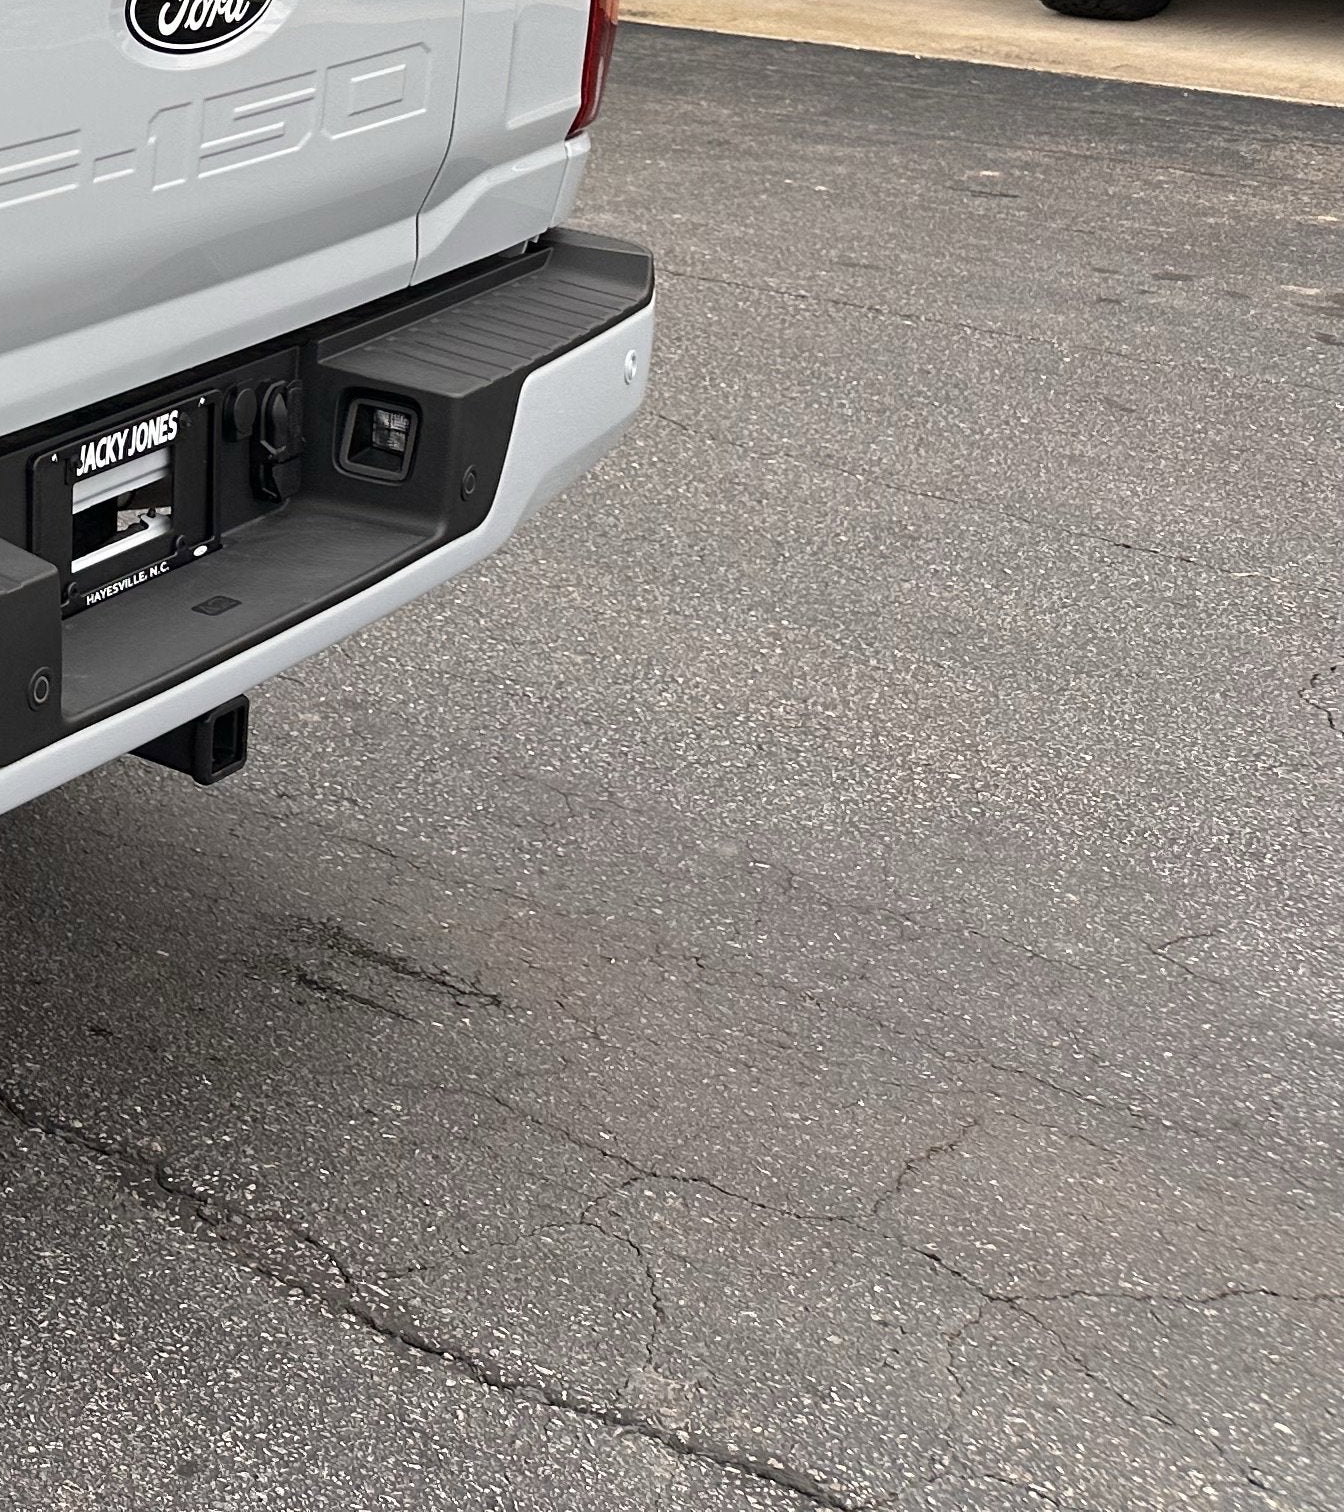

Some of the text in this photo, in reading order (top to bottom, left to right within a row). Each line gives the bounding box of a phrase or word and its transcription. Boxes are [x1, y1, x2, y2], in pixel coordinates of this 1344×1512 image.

[76, 409, 179, 477] JACKY JONES
[149, 561, 170, 578] N.C.
